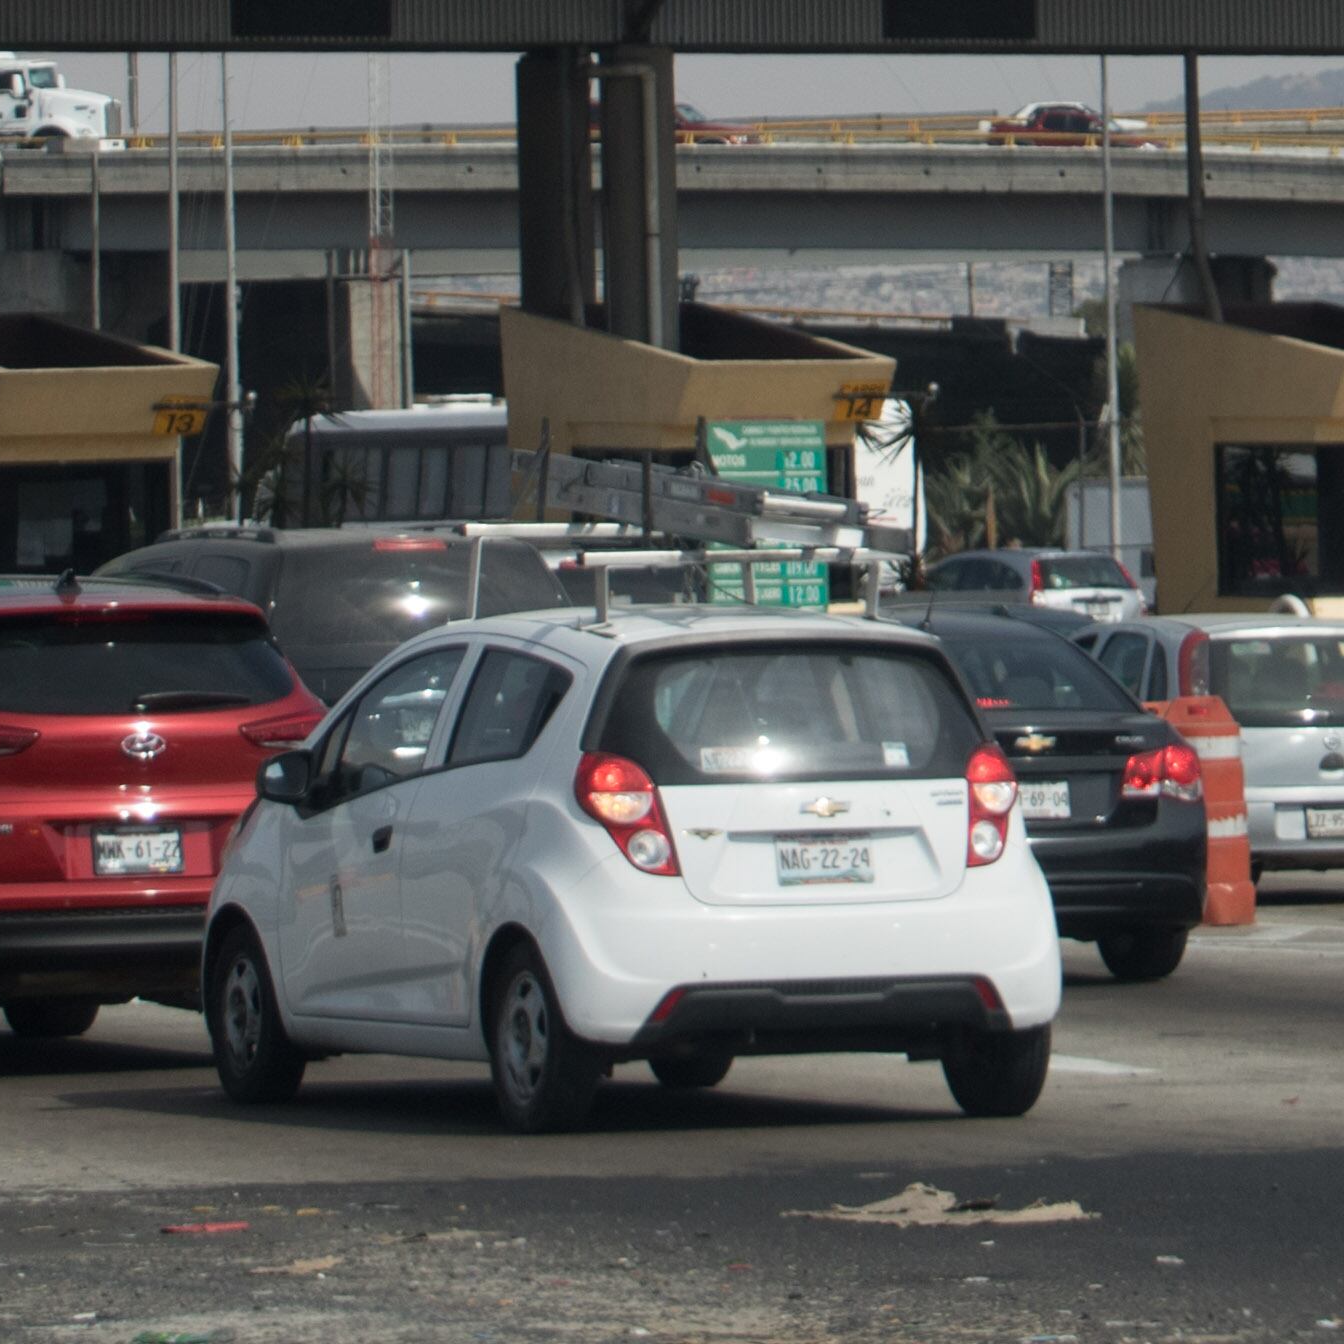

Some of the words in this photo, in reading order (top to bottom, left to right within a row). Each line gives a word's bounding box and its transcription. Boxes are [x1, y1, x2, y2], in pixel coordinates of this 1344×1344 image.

[847, 398, 872, 418] 14
[166, 414, 194, 432] 13
[779, 848, 871, 870] NAG-22-24
